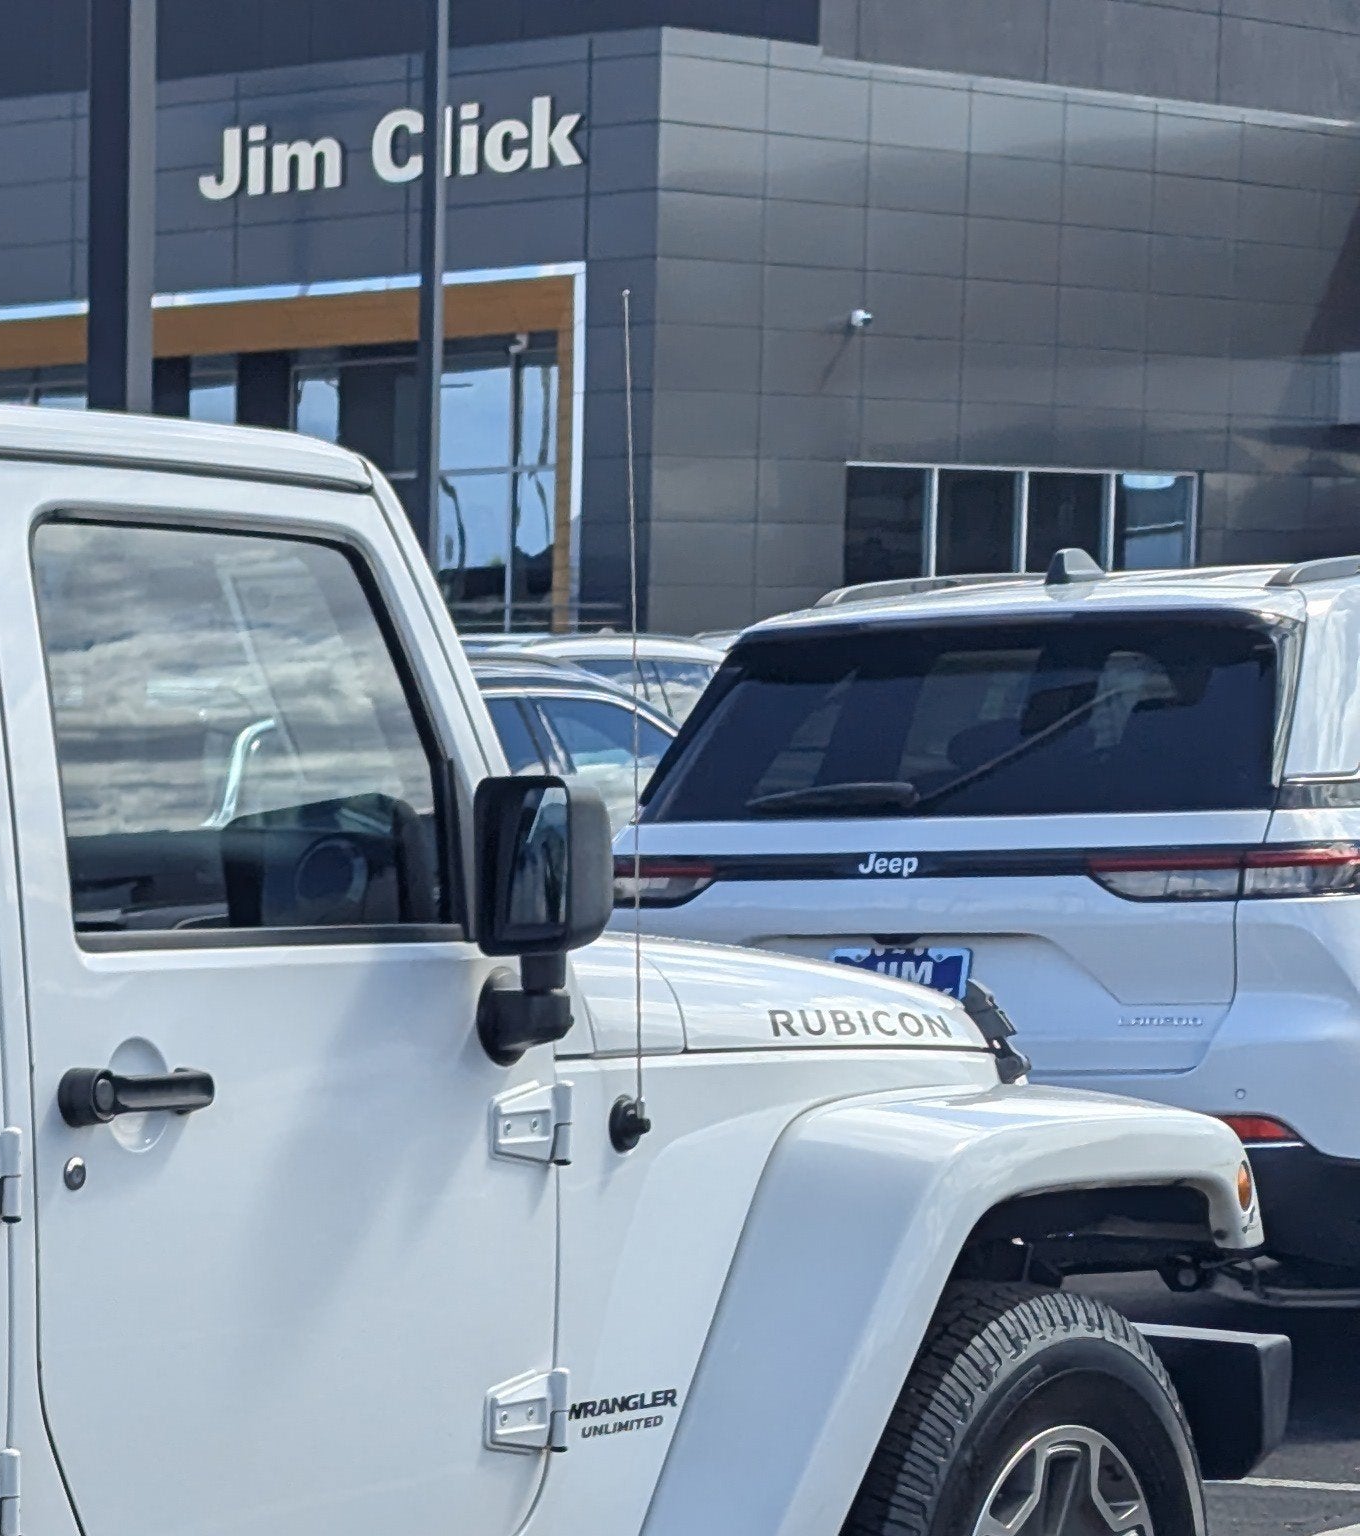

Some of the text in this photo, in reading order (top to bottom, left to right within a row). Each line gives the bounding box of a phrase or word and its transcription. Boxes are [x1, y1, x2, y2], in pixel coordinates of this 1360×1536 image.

[198, 125, 343, 200] Jim
[858, 852, 919, 878] Jeep
[768, 1009, 953, 1038] RUBICON
[568, 1388, 678, 1421] WRANGLER
[581, 1415, 664, 1439] UNLIMITED
